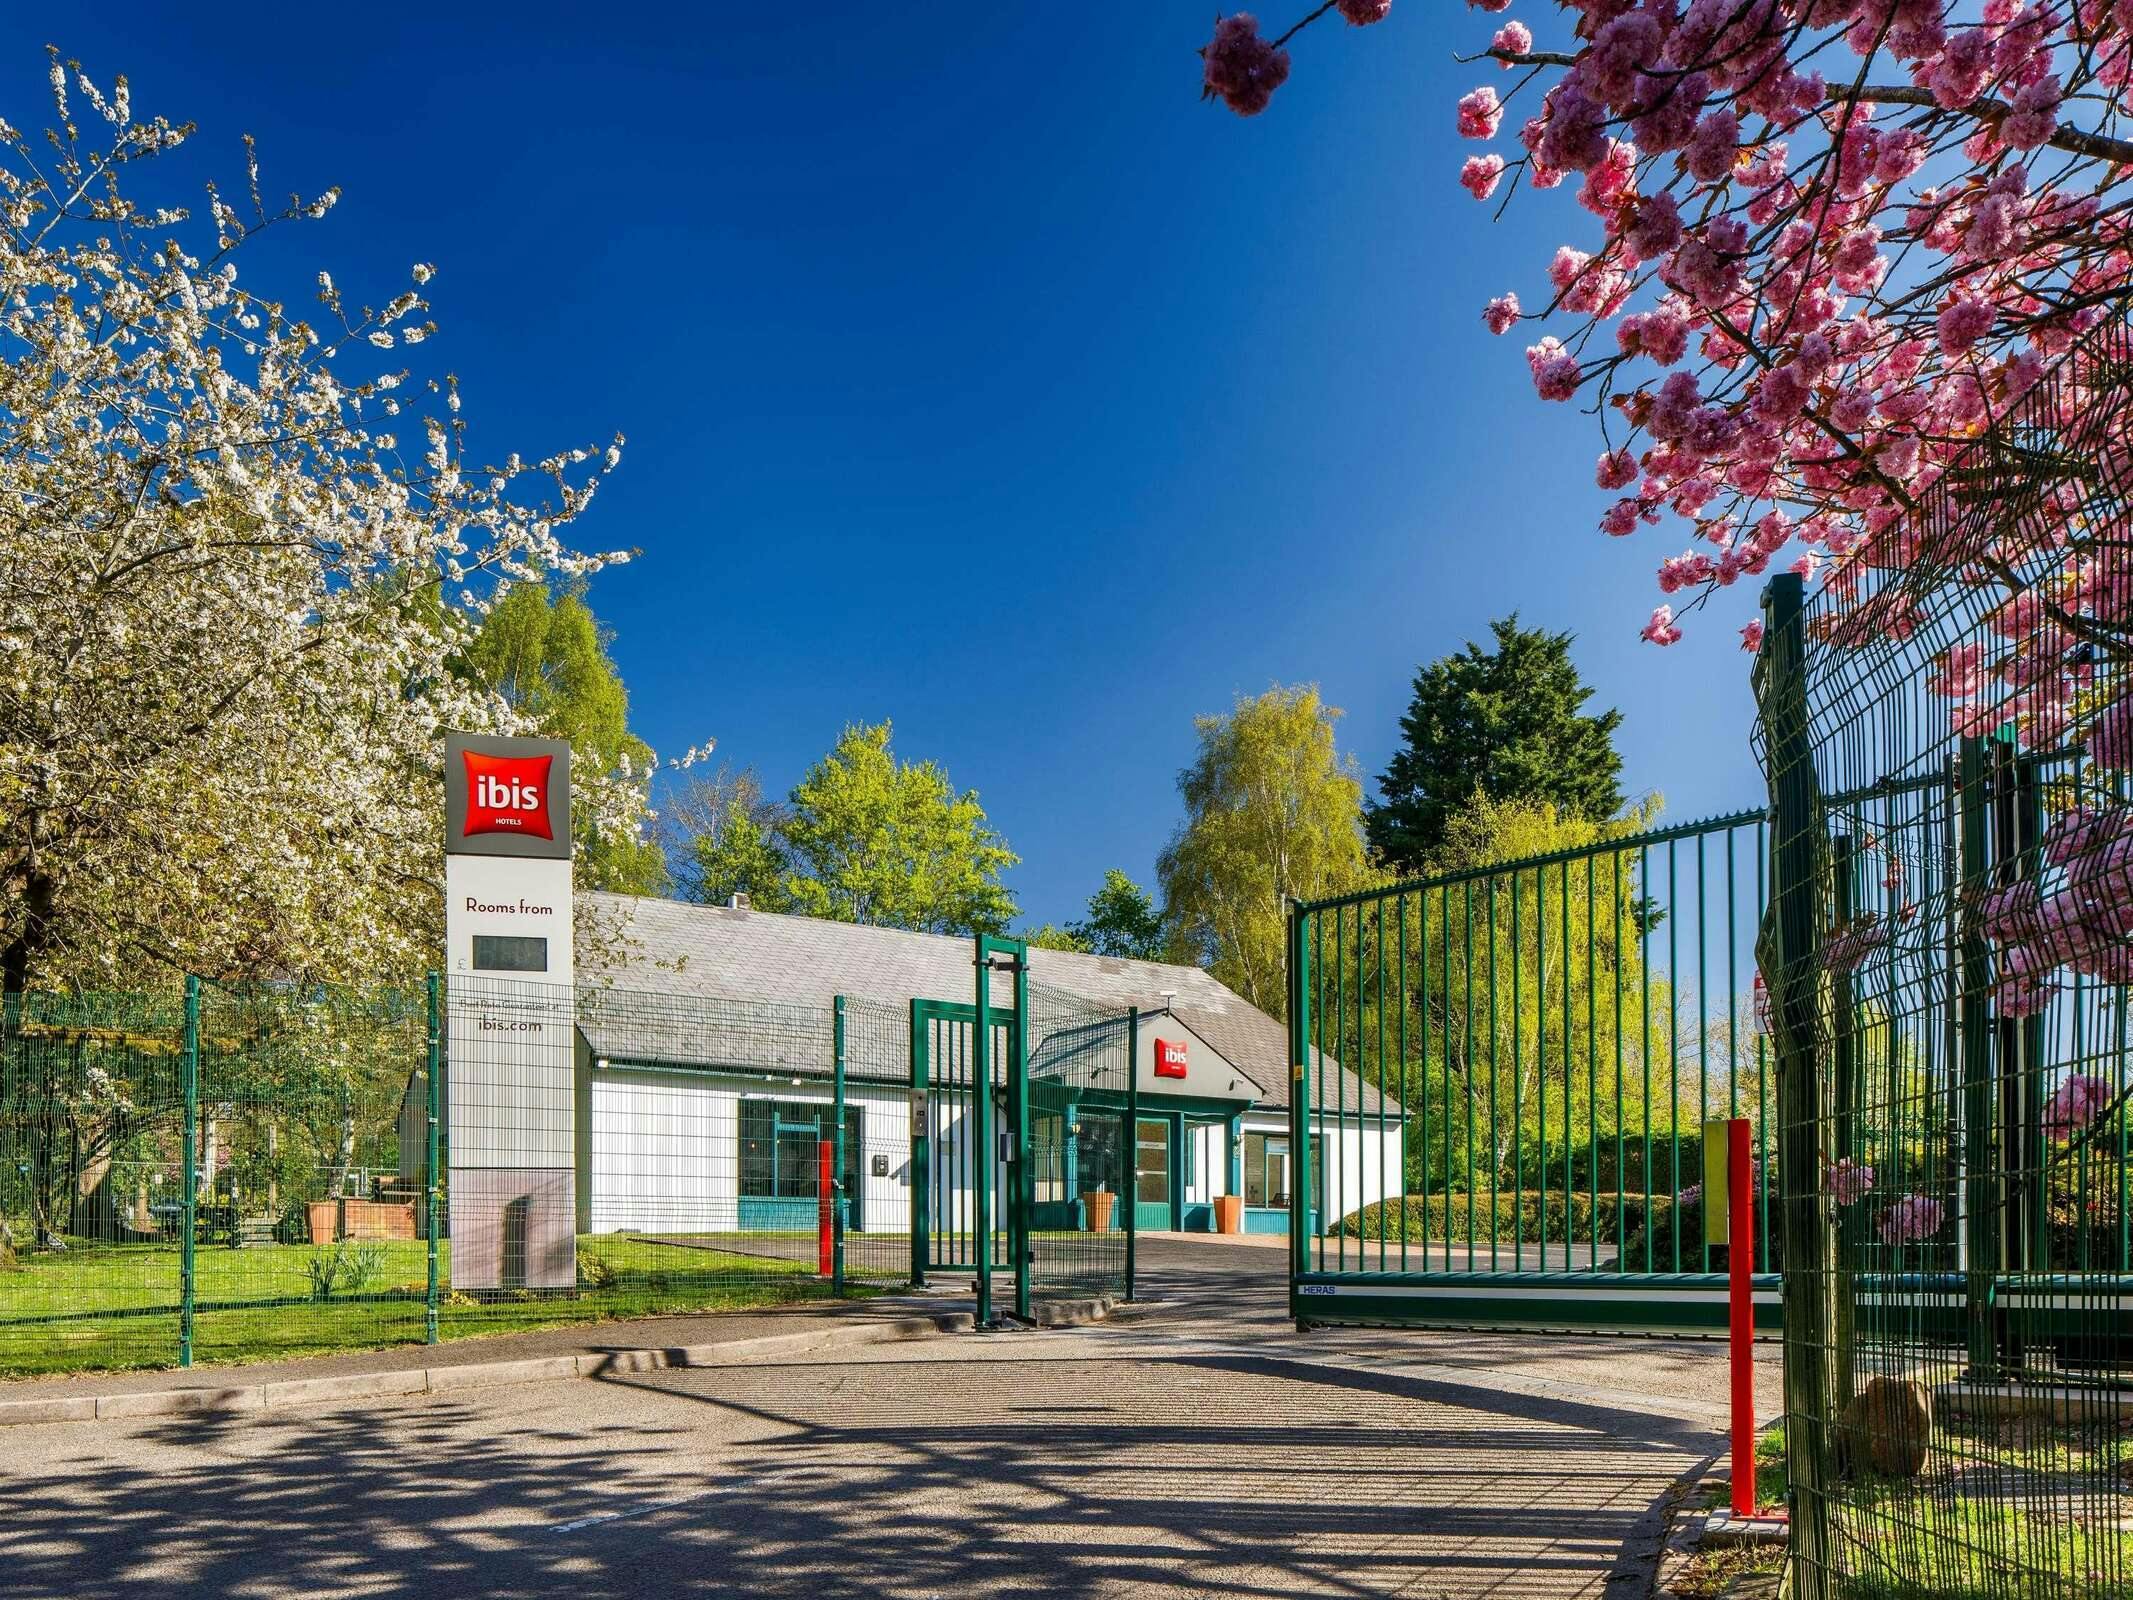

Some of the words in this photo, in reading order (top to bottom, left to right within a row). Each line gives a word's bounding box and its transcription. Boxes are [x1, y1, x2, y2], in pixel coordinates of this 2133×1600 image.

[478, 775, 539, 810] ibis
[495, 818, 522, 826] HOTELS
[466, 897, 515, 914] Rooms
[519, 898, 553, 915] from
[479, 1014, 542, 1032] ibis.com
[1165, 1047, 1186, 1064] ibis
[1303, 1286, 1336, 1295] HERAS
